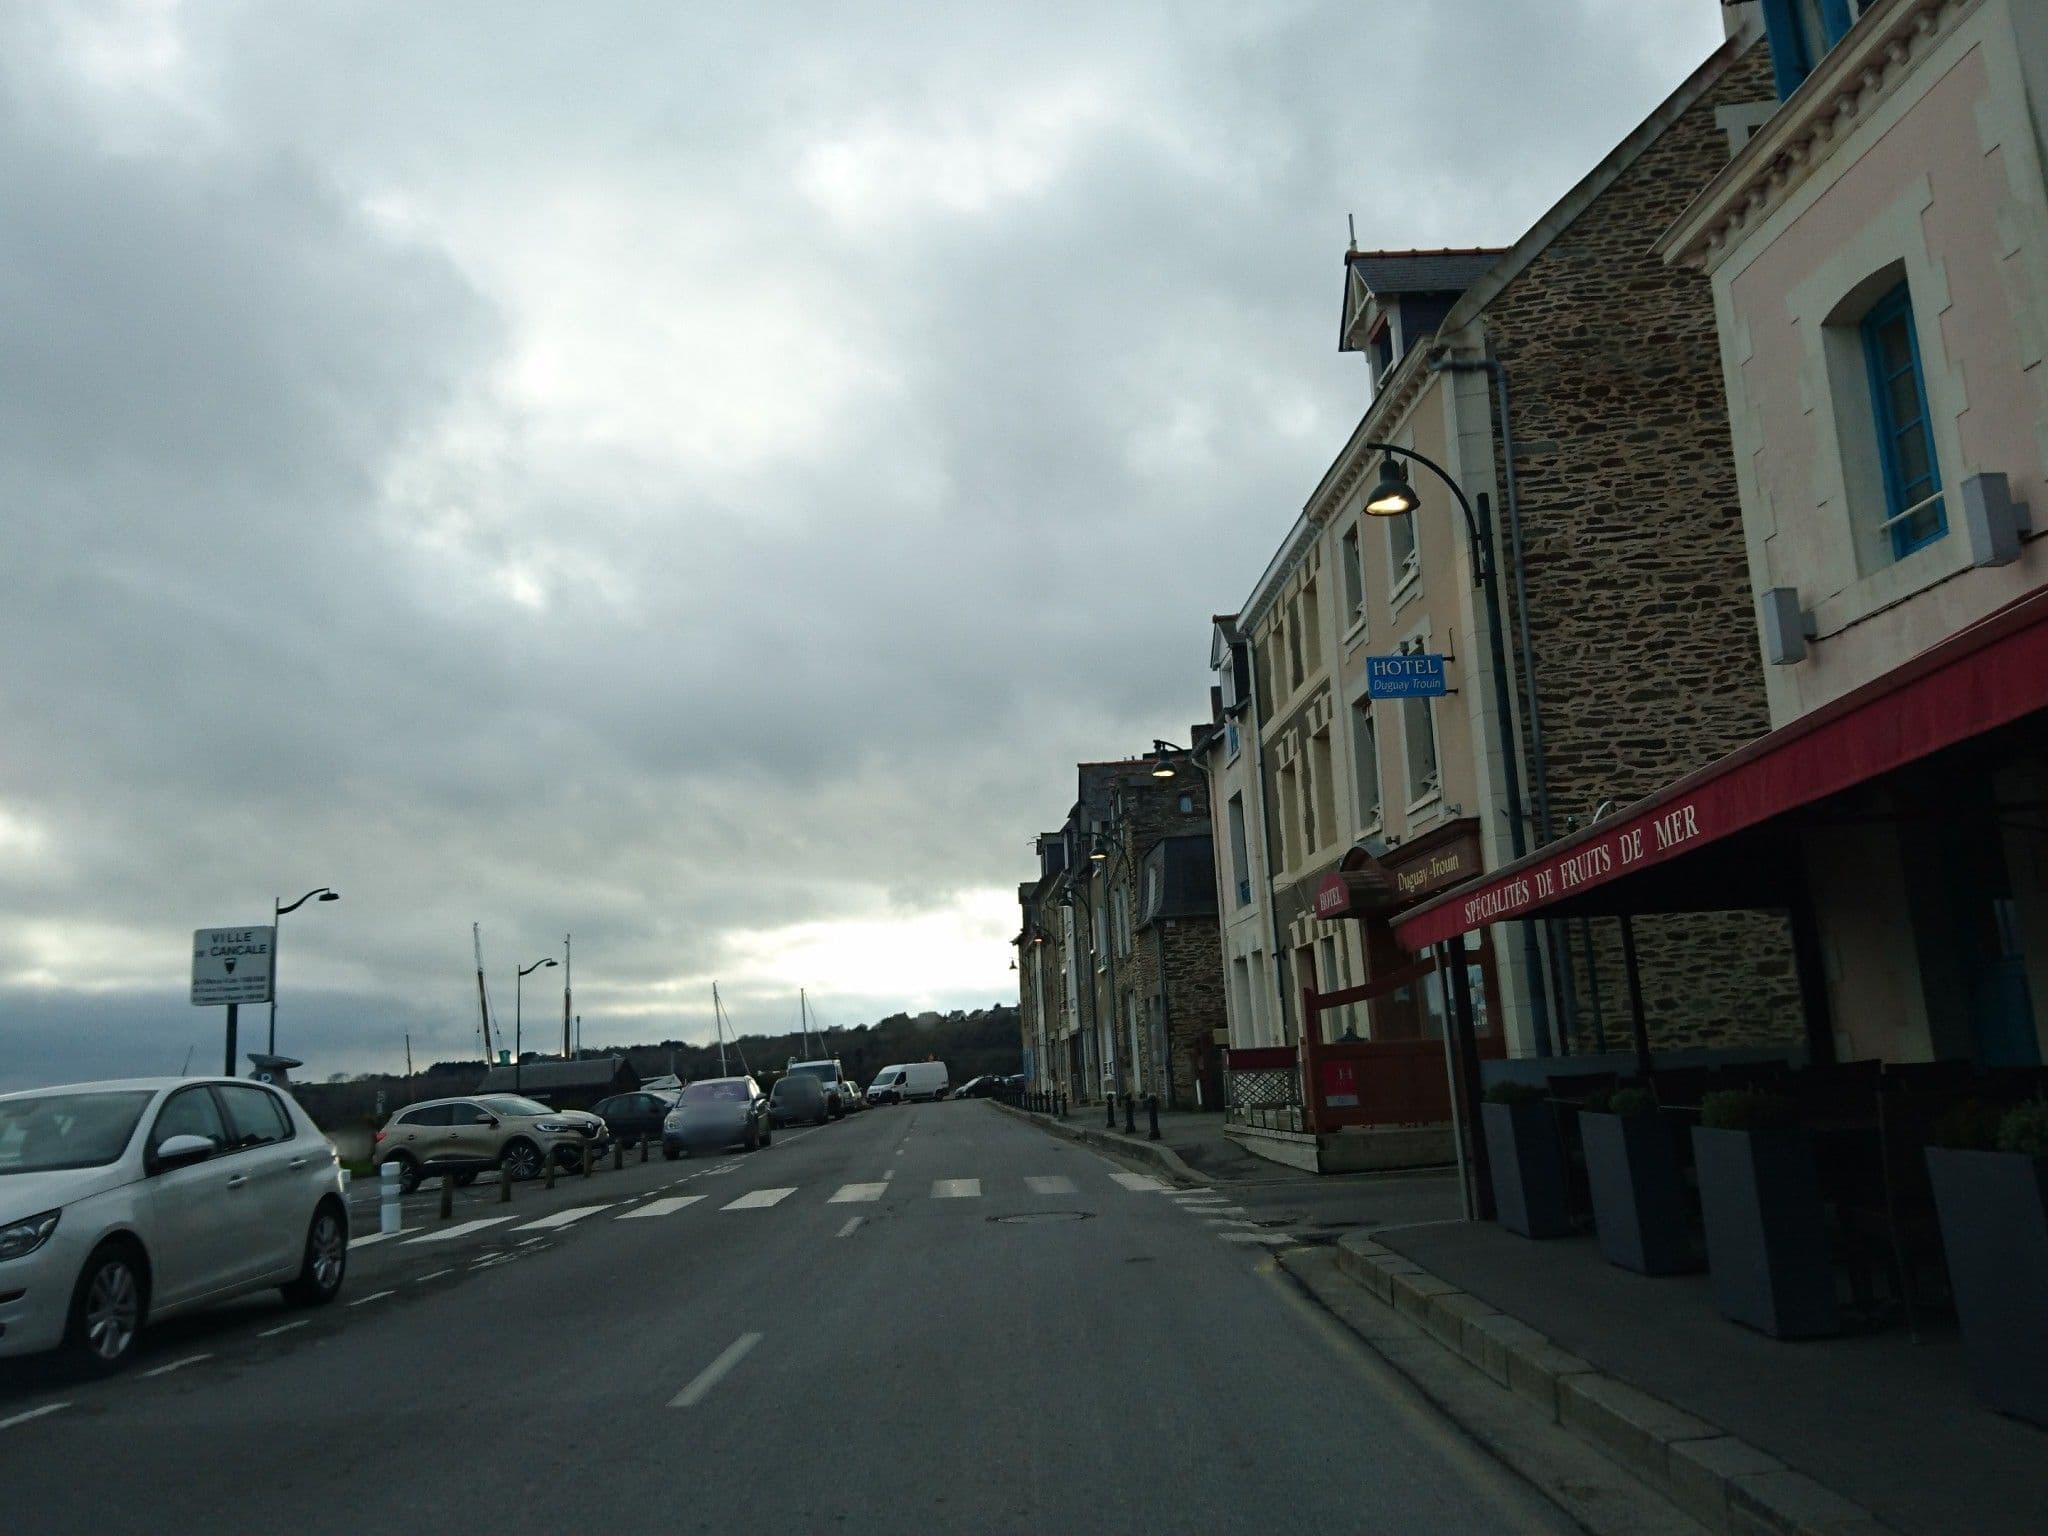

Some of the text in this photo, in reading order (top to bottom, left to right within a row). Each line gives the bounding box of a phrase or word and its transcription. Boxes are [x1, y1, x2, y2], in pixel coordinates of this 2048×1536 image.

[1374, 660, 1439, 676] HOTEL
[1374, 679, 1409, 692] Duguay
[1465, 805, 1700, 924] SPÉCIALITÉS DE FRUITS DE MER
[1320, 887, 1342, 911] HOTEL
[211, 931, 252, 942] VILLE
[210, 944, 267, 956] CANCALE
